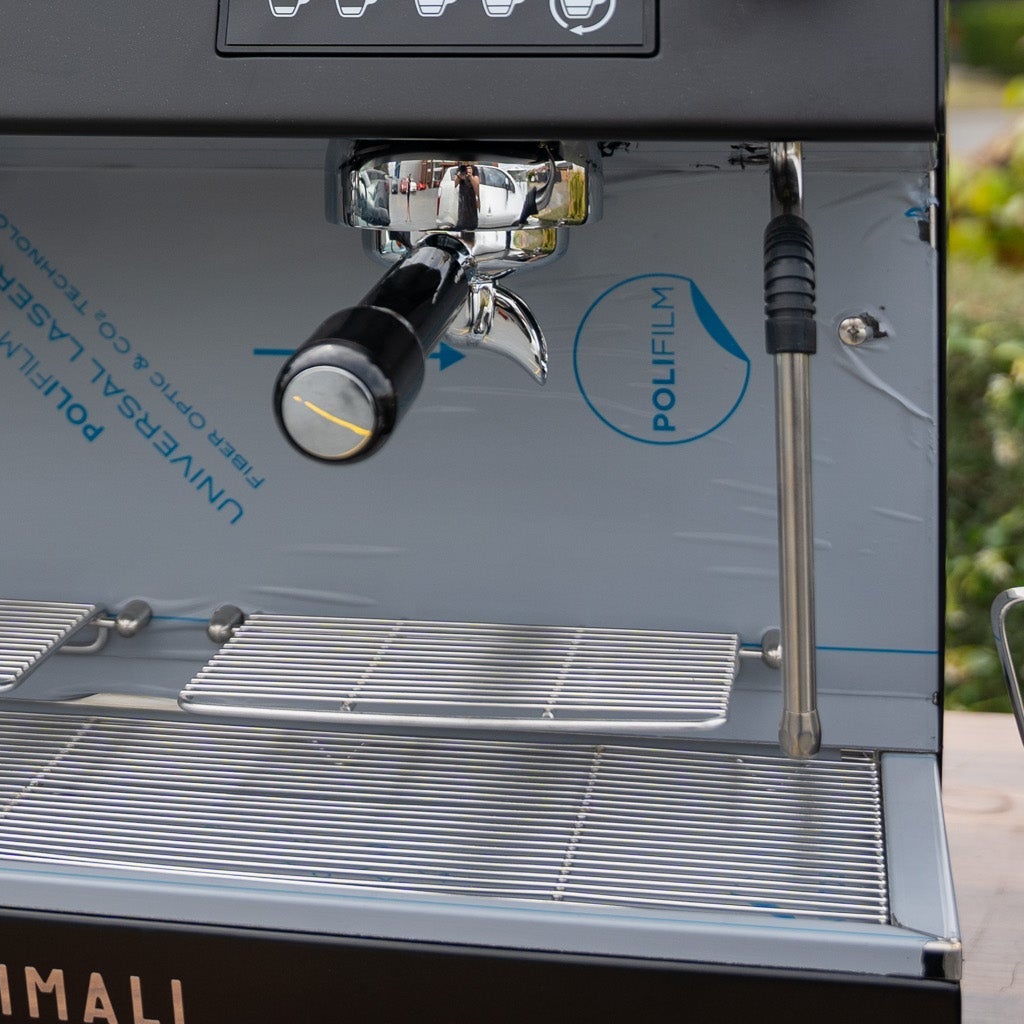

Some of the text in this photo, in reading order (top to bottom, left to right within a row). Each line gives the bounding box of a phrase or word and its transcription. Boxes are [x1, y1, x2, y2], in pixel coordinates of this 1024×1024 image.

[133, 354, 149, 370] &
[651, 286, 676, 431] POLIFILM
[148, 371, 207, 430] OPTIC
[91, 357, 245, 525] UNIVERSAL
[207, 429, 266, 489] FIBER
